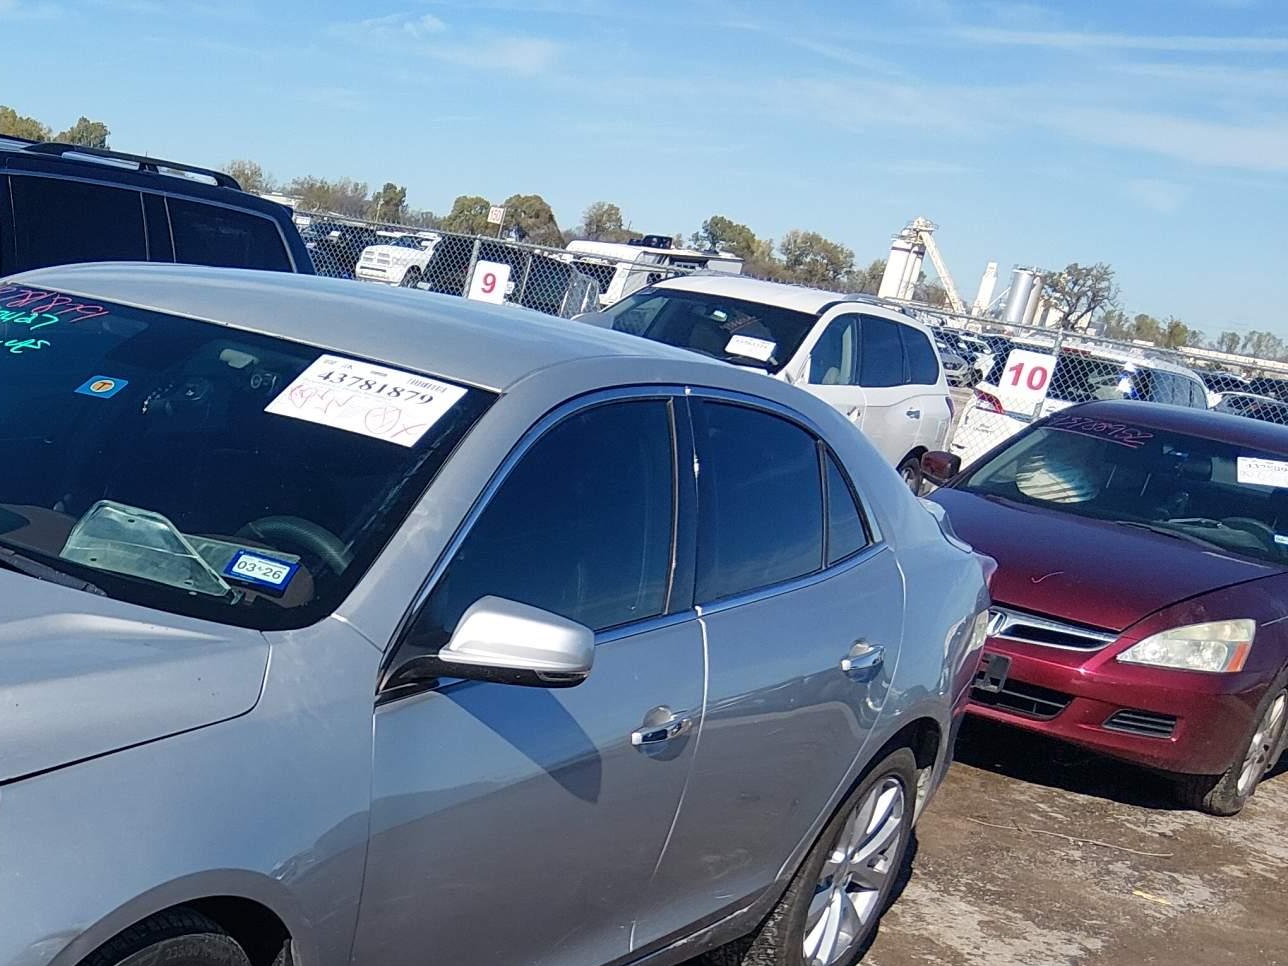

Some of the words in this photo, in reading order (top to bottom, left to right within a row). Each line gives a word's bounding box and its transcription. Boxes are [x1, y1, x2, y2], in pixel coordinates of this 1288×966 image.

[481, 272, 497, 294] 9
[318, 369, 434, 405] 43781879
[1008, 362, 1048, 391] 10
[237, 560, 257, 573] 03
[262, 567, 283, 580] 26
